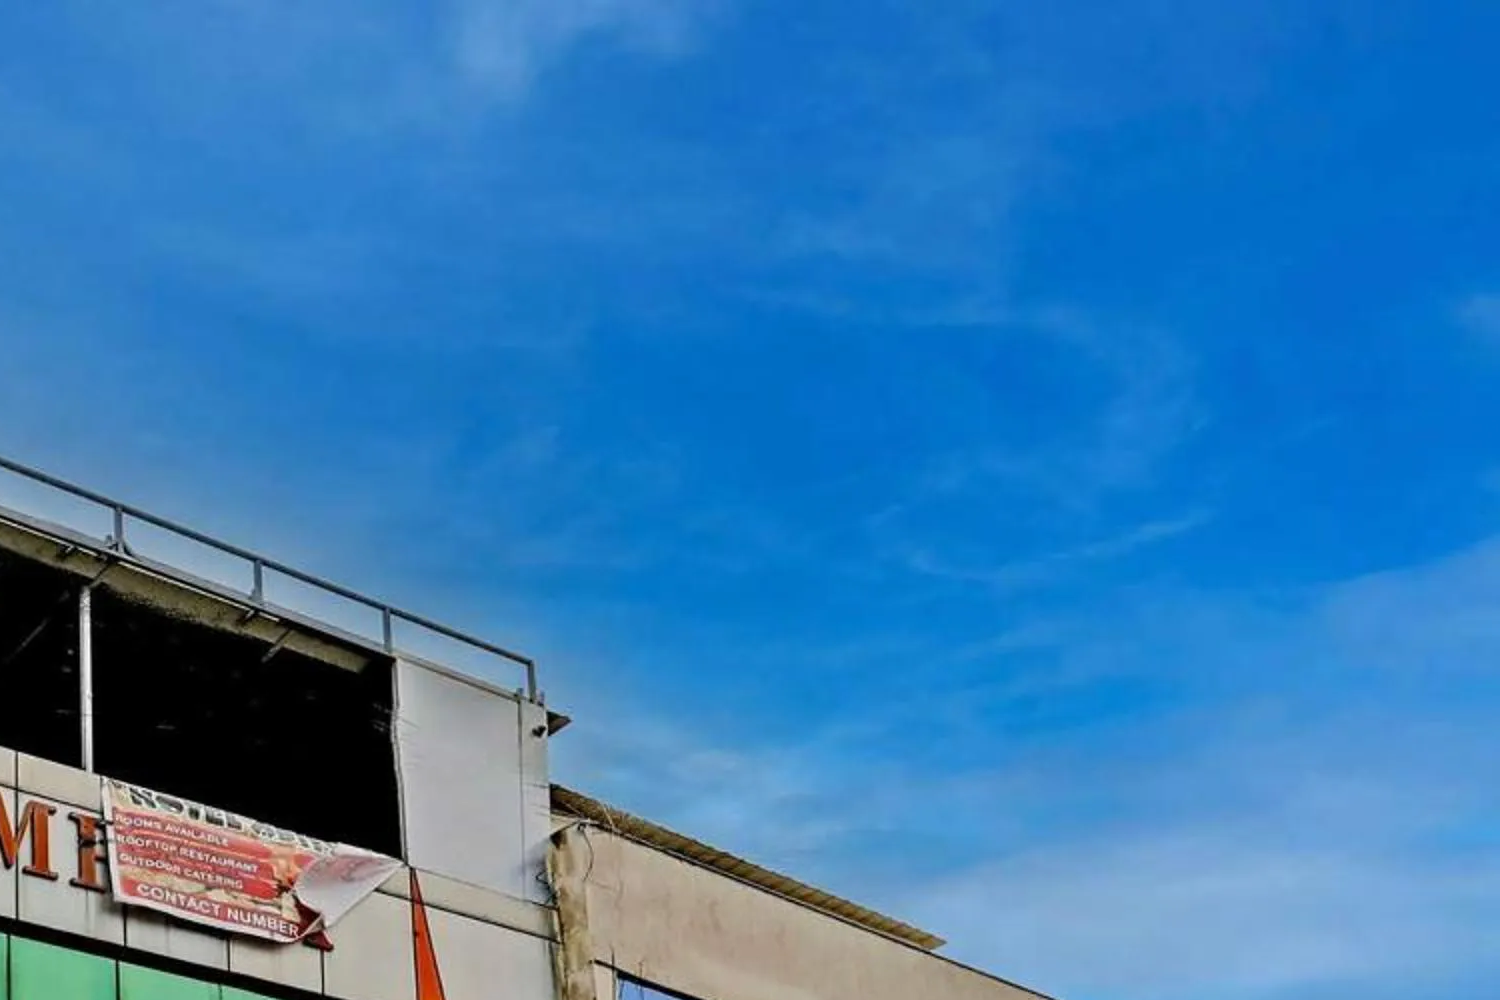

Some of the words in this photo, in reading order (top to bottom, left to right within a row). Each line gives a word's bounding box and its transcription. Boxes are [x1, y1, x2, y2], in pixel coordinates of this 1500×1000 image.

[116, 814, 161, 831] ROOMS
[165, 824, 229, 847] AVAILABLE
[117, 834, 176, 853] ROOFTOP
[179, 848, 259, 873] RESTAURANT
[119, 853, 181, 875] OUTDOOR
[184, 869, 243, 889] CATERING
[137, 882, 221, 916] CONTACT
[227, 907, 299, 937] NUMBER
